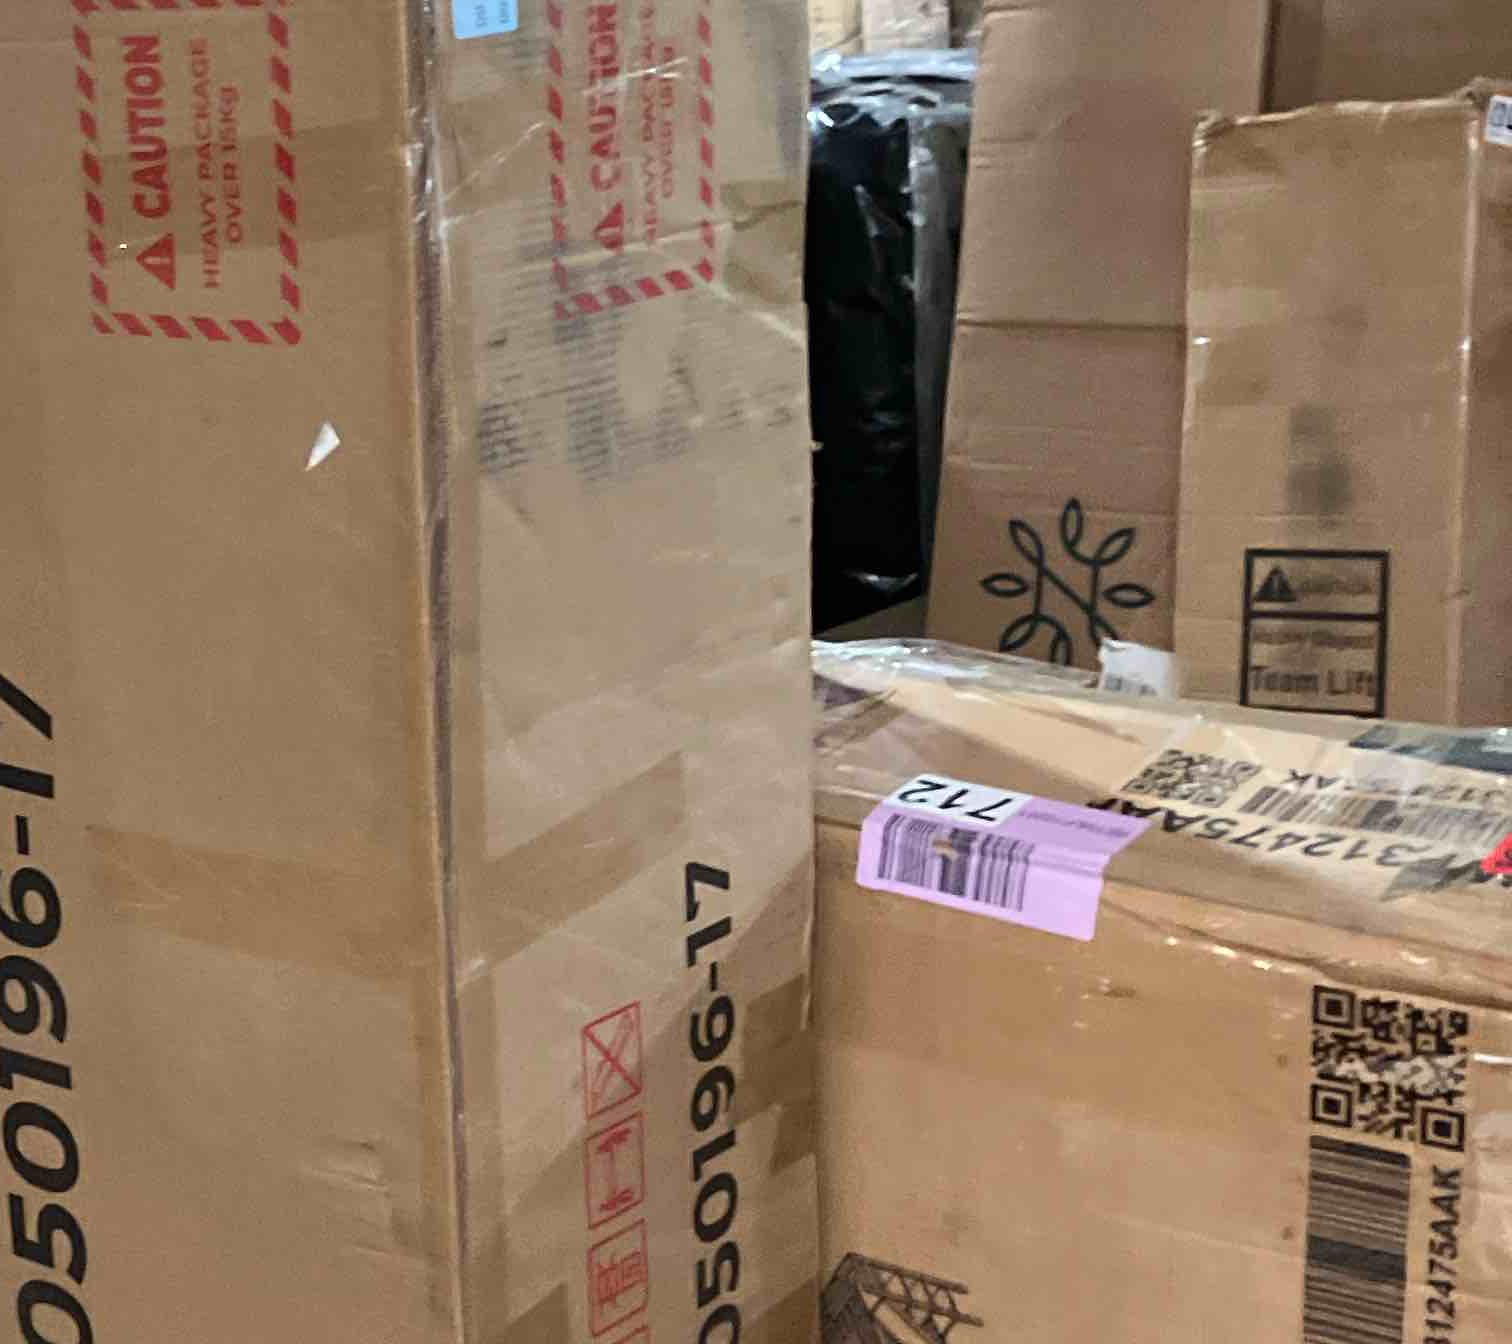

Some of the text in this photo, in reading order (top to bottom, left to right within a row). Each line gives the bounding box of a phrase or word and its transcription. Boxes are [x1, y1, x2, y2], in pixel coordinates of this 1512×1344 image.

[120, 35, 173, 220] CAUTION
[189, 38, 220, 289] HEAVY PACKAGE
[586, 3, 621, 191] CAUTION
[222, 163, 243, 243] OVER
[898, 779, 1014, 822] 712
